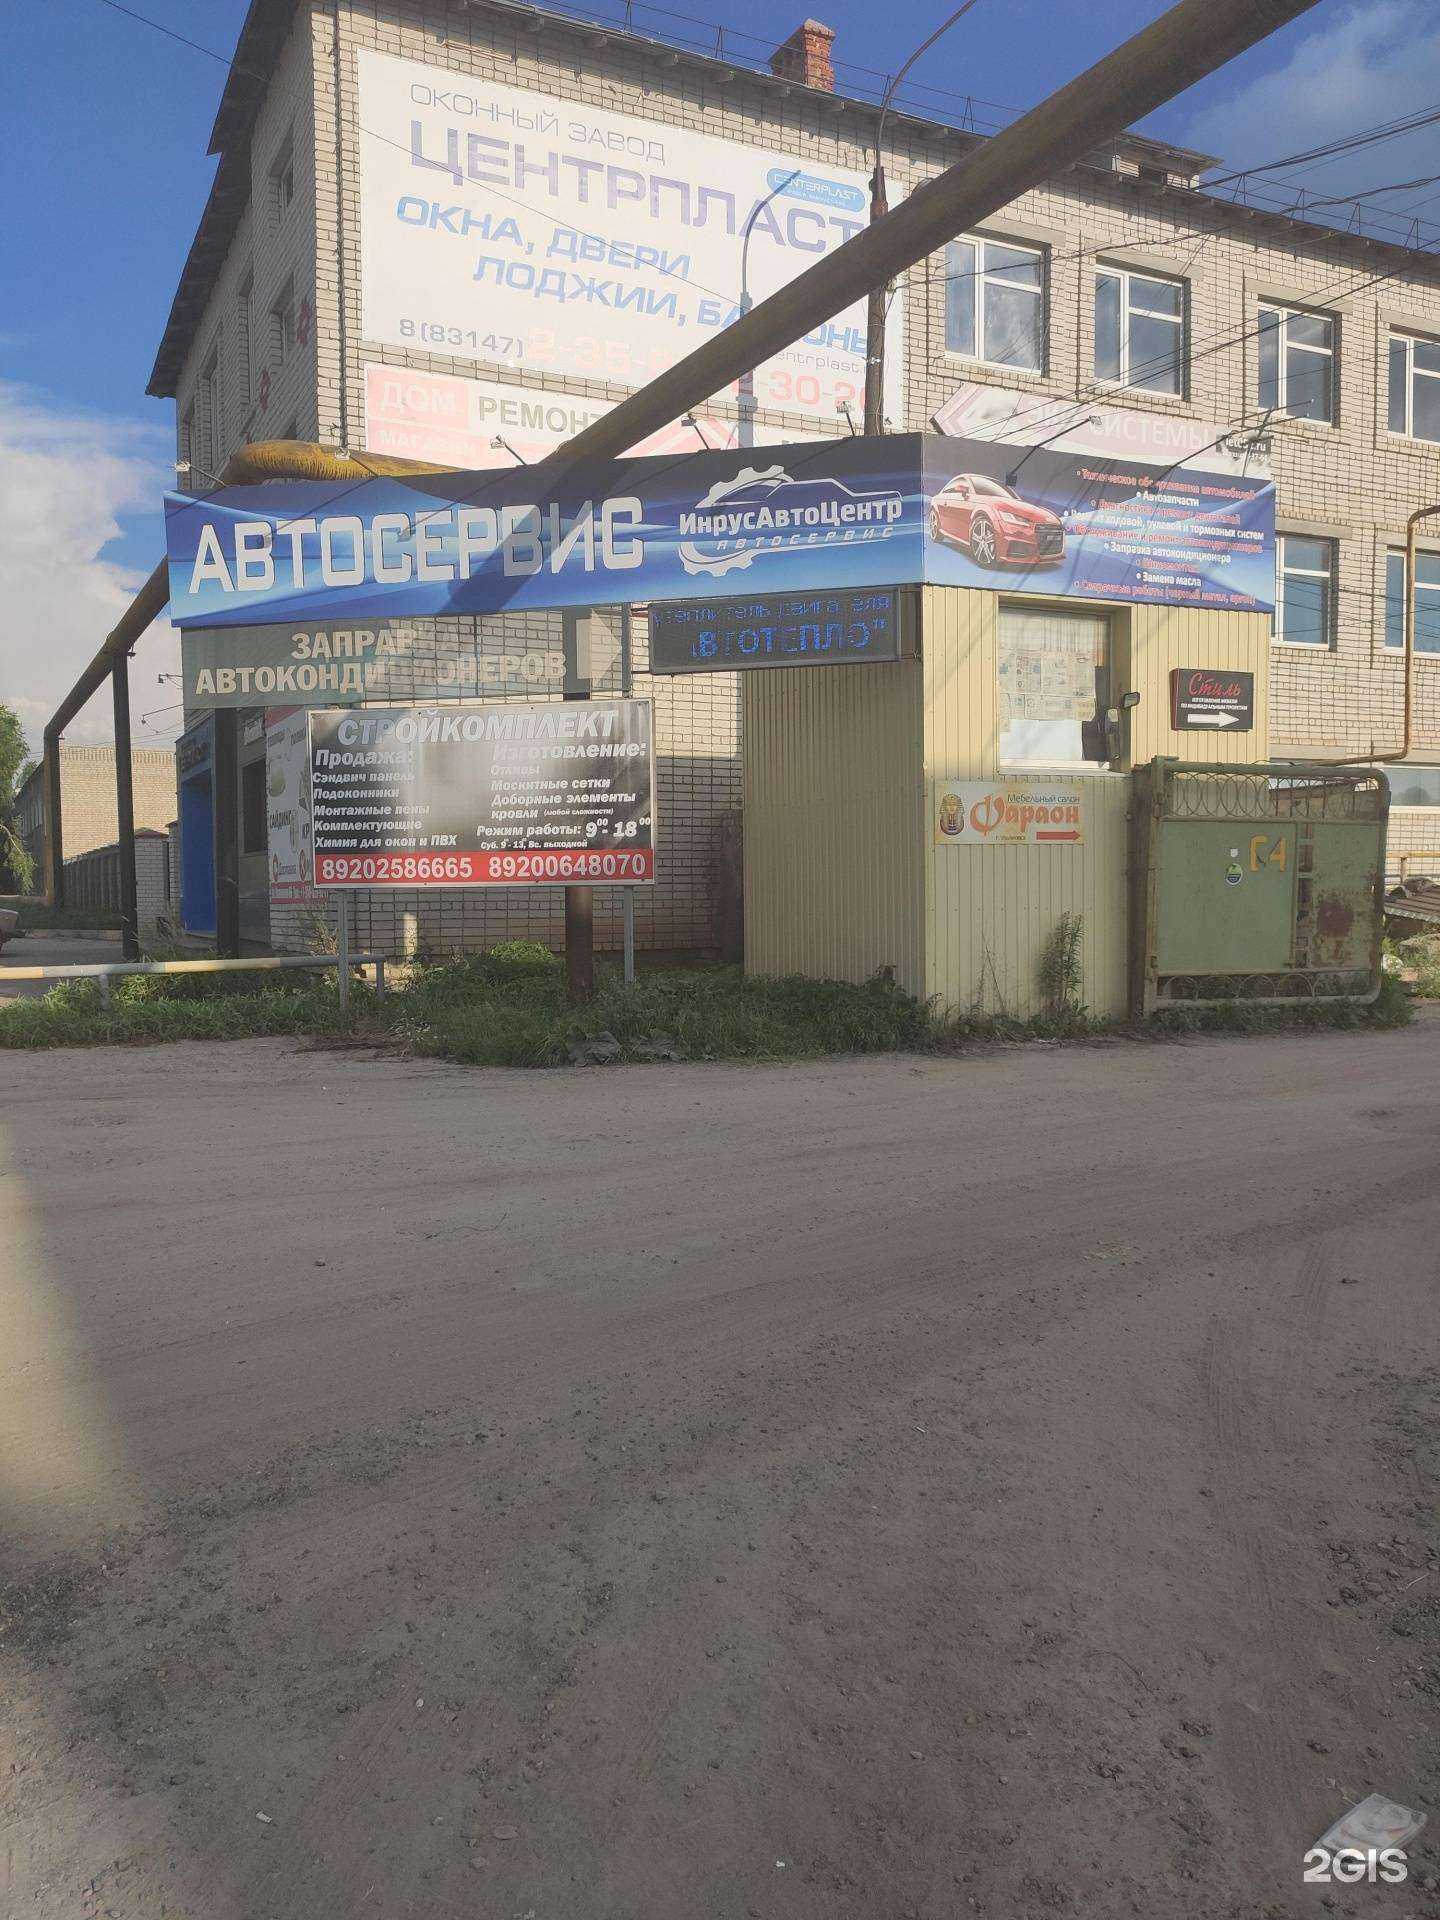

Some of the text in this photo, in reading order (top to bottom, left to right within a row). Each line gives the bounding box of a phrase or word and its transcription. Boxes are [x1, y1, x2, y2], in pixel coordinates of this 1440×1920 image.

[410, 83, 666, 165] ОКОННЫЙ ЗАВОД
[410, 119, 867, 254] ЦЕНТРПЛАСТ
[395, 195, 691, 280] ОКНА, ДВЕРИ
[473, 255, 686, 327] ЛОДЖИИ,
[380, 382, 457, 416] ДОМ
[1142, 490, 1200, 507] Автозапчасти
[680, 500, 903, 536] ИнрусАвтоЦентр
[716, 527, 893, 550] АВТОСЕРВИС
[1190, 524, 1236, 540] тормозных
[1237, 529, 1265, 541] систем
[188, 495, 644, 594] АВТОСЕРВИС
[1110, 541, 1231, 564] Заправка автокондиционера
[1142, 572, 1202, 587] Замена масла
[337, 709, 619, 746] СТРОЙКОМПЛЕКТ
[315, 749, 415, 769] Продажа:
[492, 742, 647, 761] Изготовление:
[312, 772, 366, 784] Сэндвич
[490, 778, 611, 792] Москитные сетки
[313, 788, 400, 801] Подоконники
[491, 792, 636, 808] Доборные элементы
[314, 805, 392, 816] Монтажные
[969, 795, 1081, 837] Фараон
[314, 820, 423, 833] Комплектующие
[476, 824, 523, 837] Режим
[526, 823, 582, 838] работы:
[315, 836, 358, 848] Химия
[360, 837, 381, 848] для
[384, 837, 416, 847] окон
[430, 834, 458, 846] ПВХ
[543, 839, 588, 849] выходной
[322, 857, 473, 880] 89202586665
[488, 853, 646, 878] 89200648070
